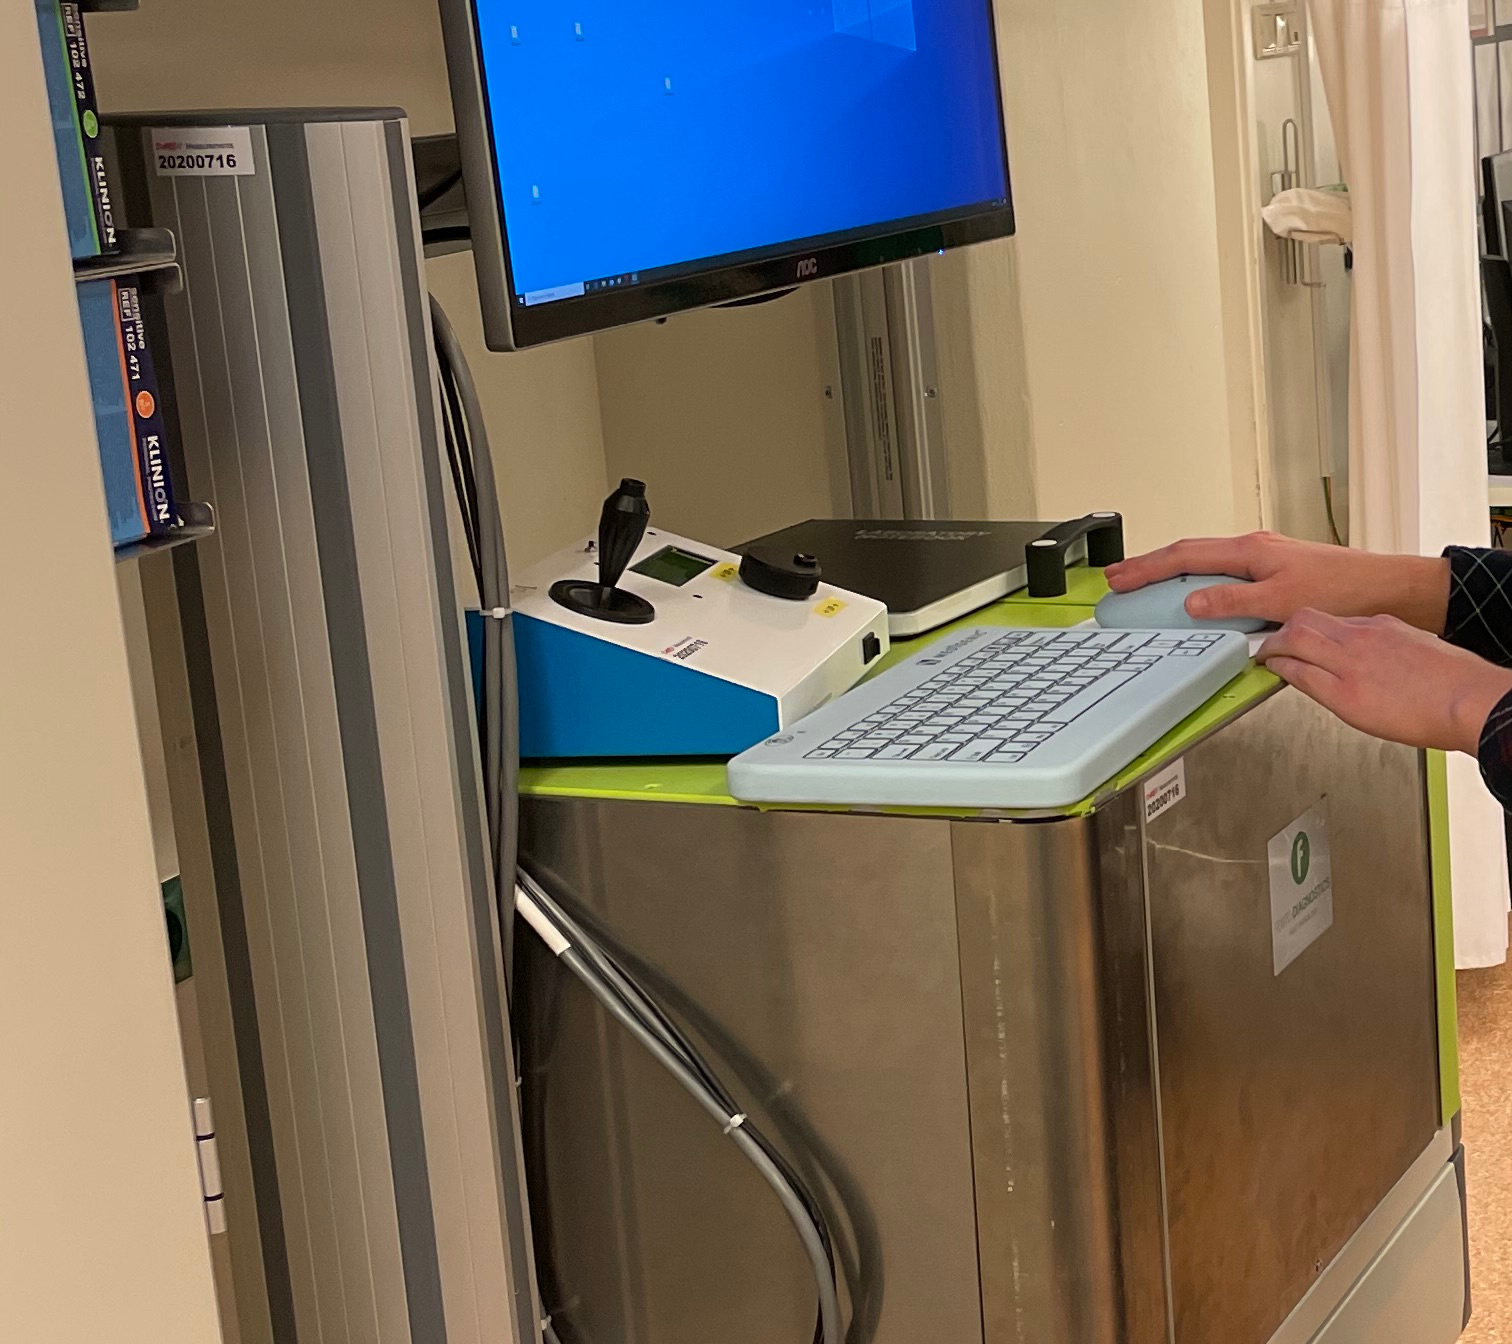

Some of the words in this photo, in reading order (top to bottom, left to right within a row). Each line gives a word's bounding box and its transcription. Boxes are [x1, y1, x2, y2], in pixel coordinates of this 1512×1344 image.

[69, 42, 81, 68] 102
[75, 72, 86, 100] 472
[158, 154, 237, 170] 20200716
[94, 157, 117, 244] KLINION
[120, 291, 132, 318] REF
[125, 326, 137, 352] 102
[129, 355, 141, 381] 471
[147, 435, 171, 521] KLINION
